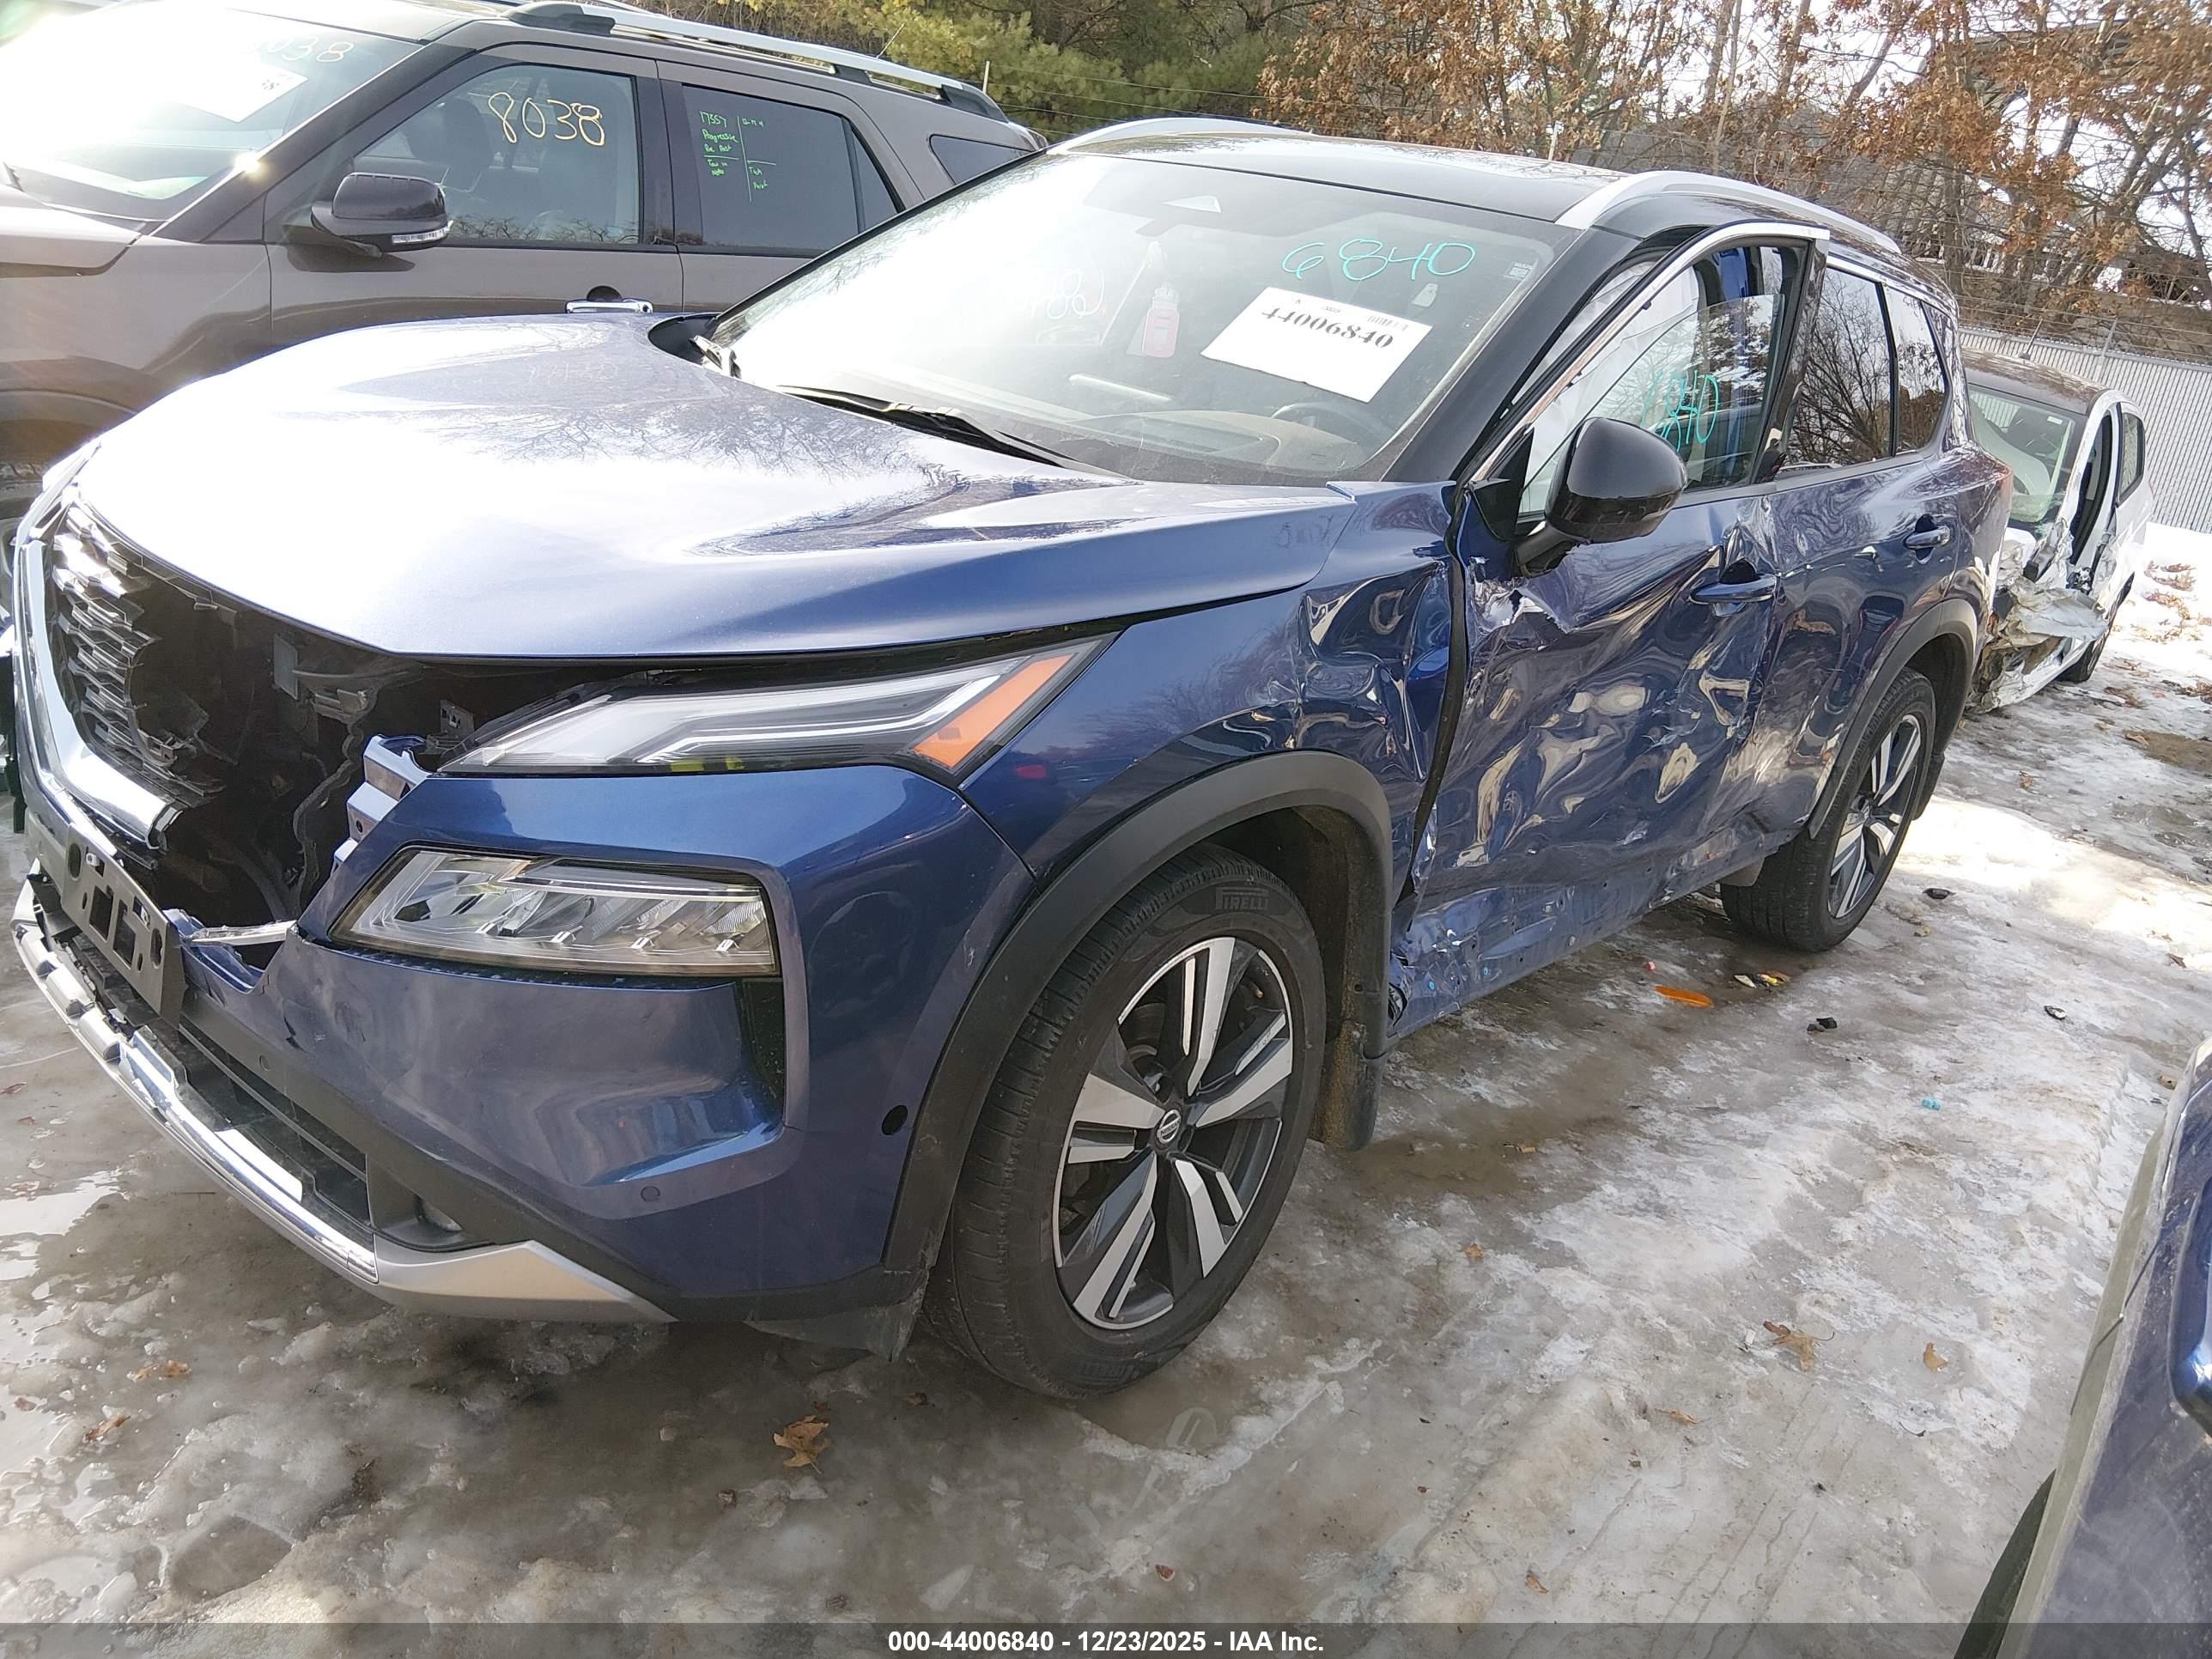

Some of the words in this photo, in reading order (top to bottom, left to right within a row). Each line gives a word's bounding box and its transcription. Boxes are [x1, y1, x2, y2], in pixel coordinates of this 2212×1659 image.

[488, 92, 605, 147] 8038
[1281, 238, 1477, 282] 6840
[1261, 307, 1395, 349] 44006840
[1215, 886, 1269, 910] PIRELLI
